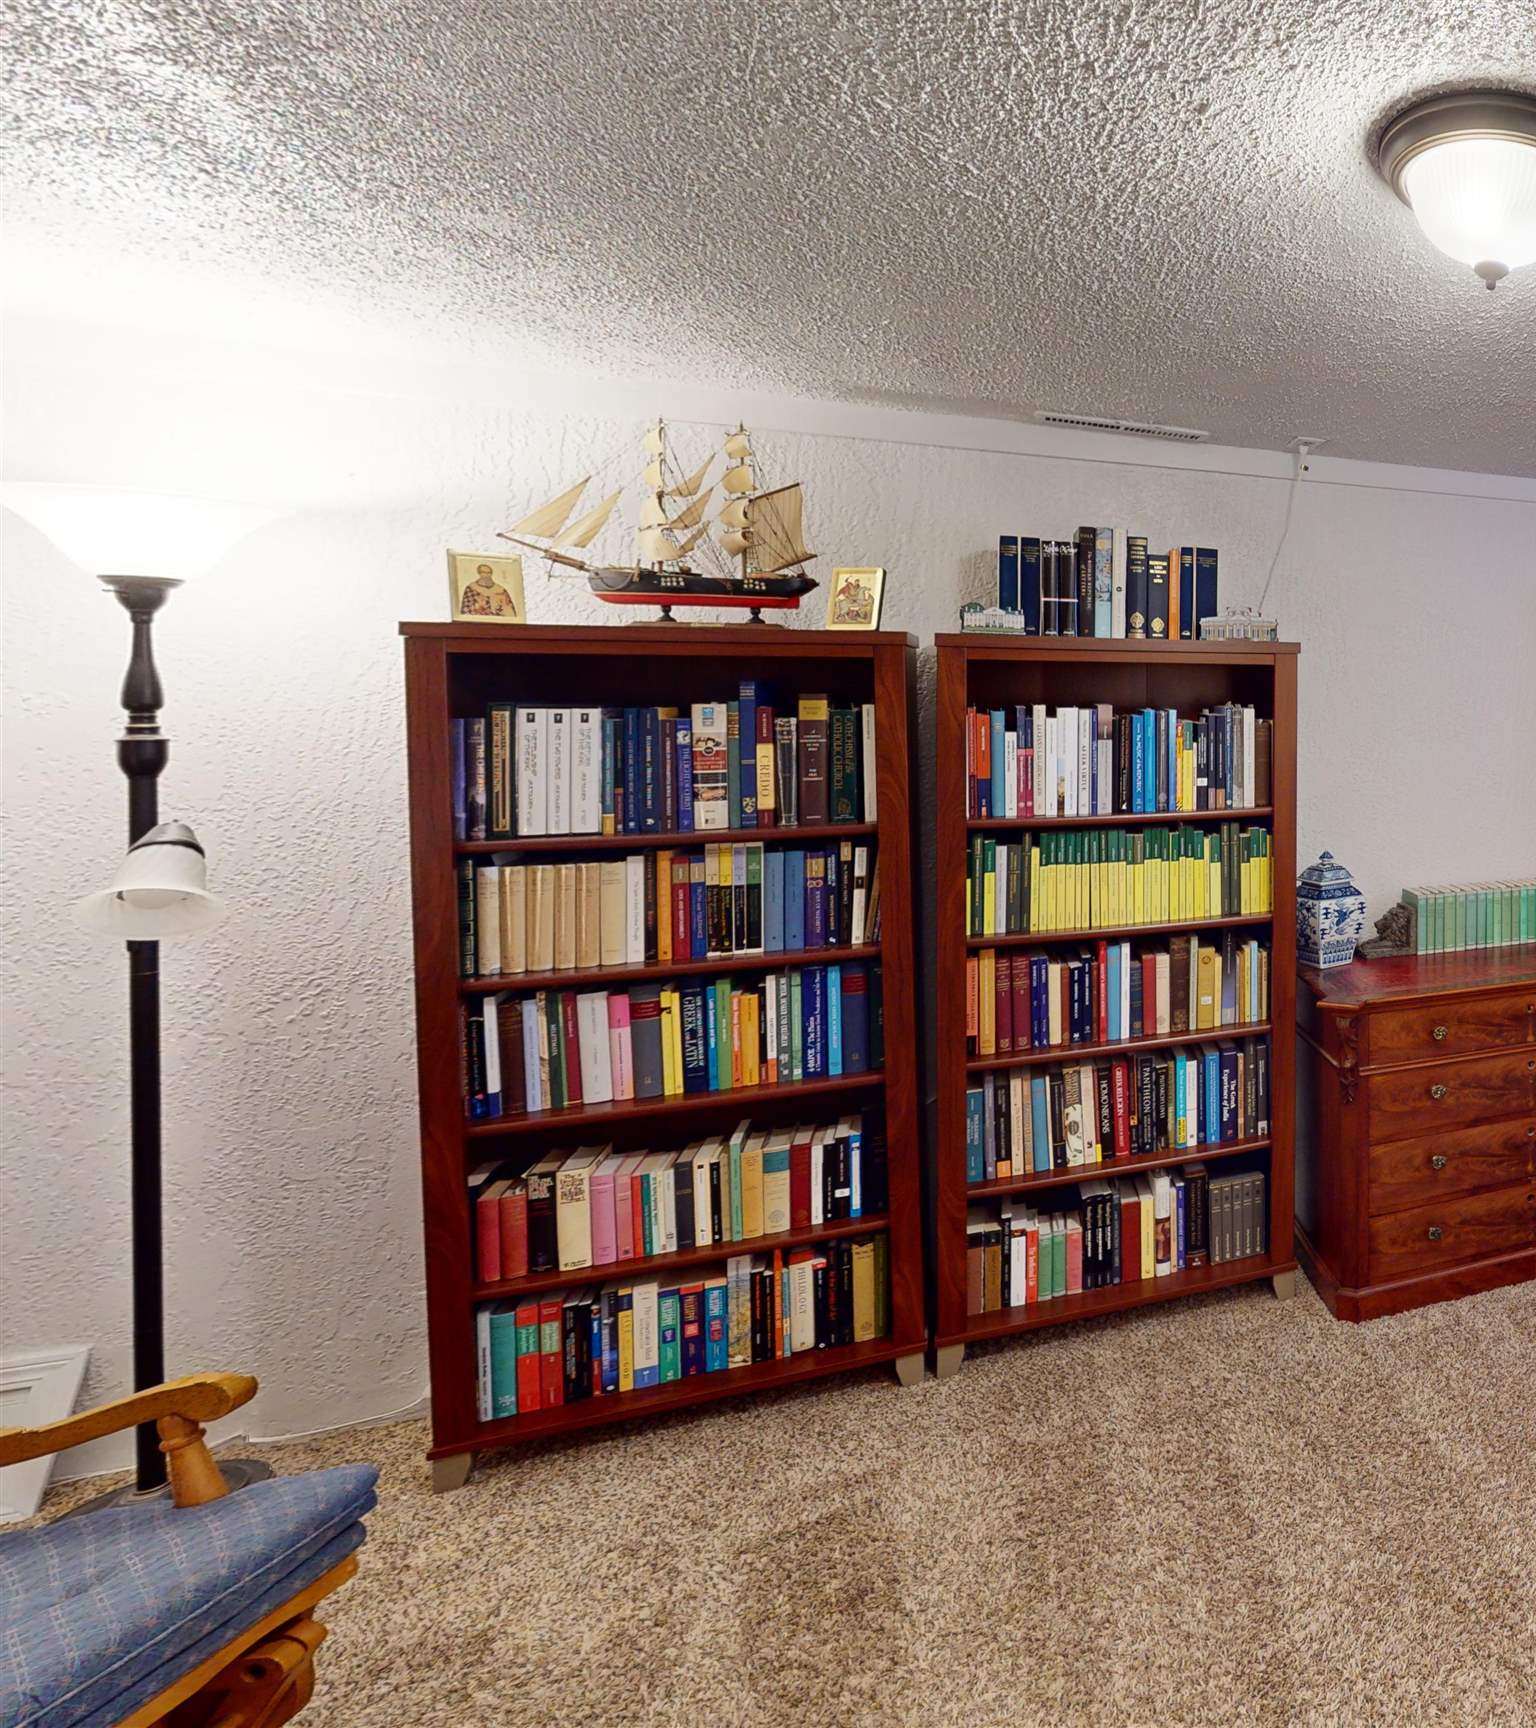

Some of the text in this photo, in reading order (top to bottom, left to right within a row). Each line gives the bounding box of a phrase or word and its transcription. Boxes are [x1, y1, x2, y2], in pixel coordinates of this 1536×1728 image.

[833, 715, 843, 790] CATHOLIC CHURCH
[845, 715, 854, 758] CATECHISM
[760, 755, 771, 797] CREDO
[684, 997, 697, 1032] GREEK
[685, 1039, 698, 1068] LATIN
[1100, 1080, 1110, 1134] HOMO NECANS
[1143, 1067, 1151, 1113] PANTHEON
[1222, 1069, 1230, 1122] Experience of India
[798, 1267, 807, 1314] PHILOLOGY
